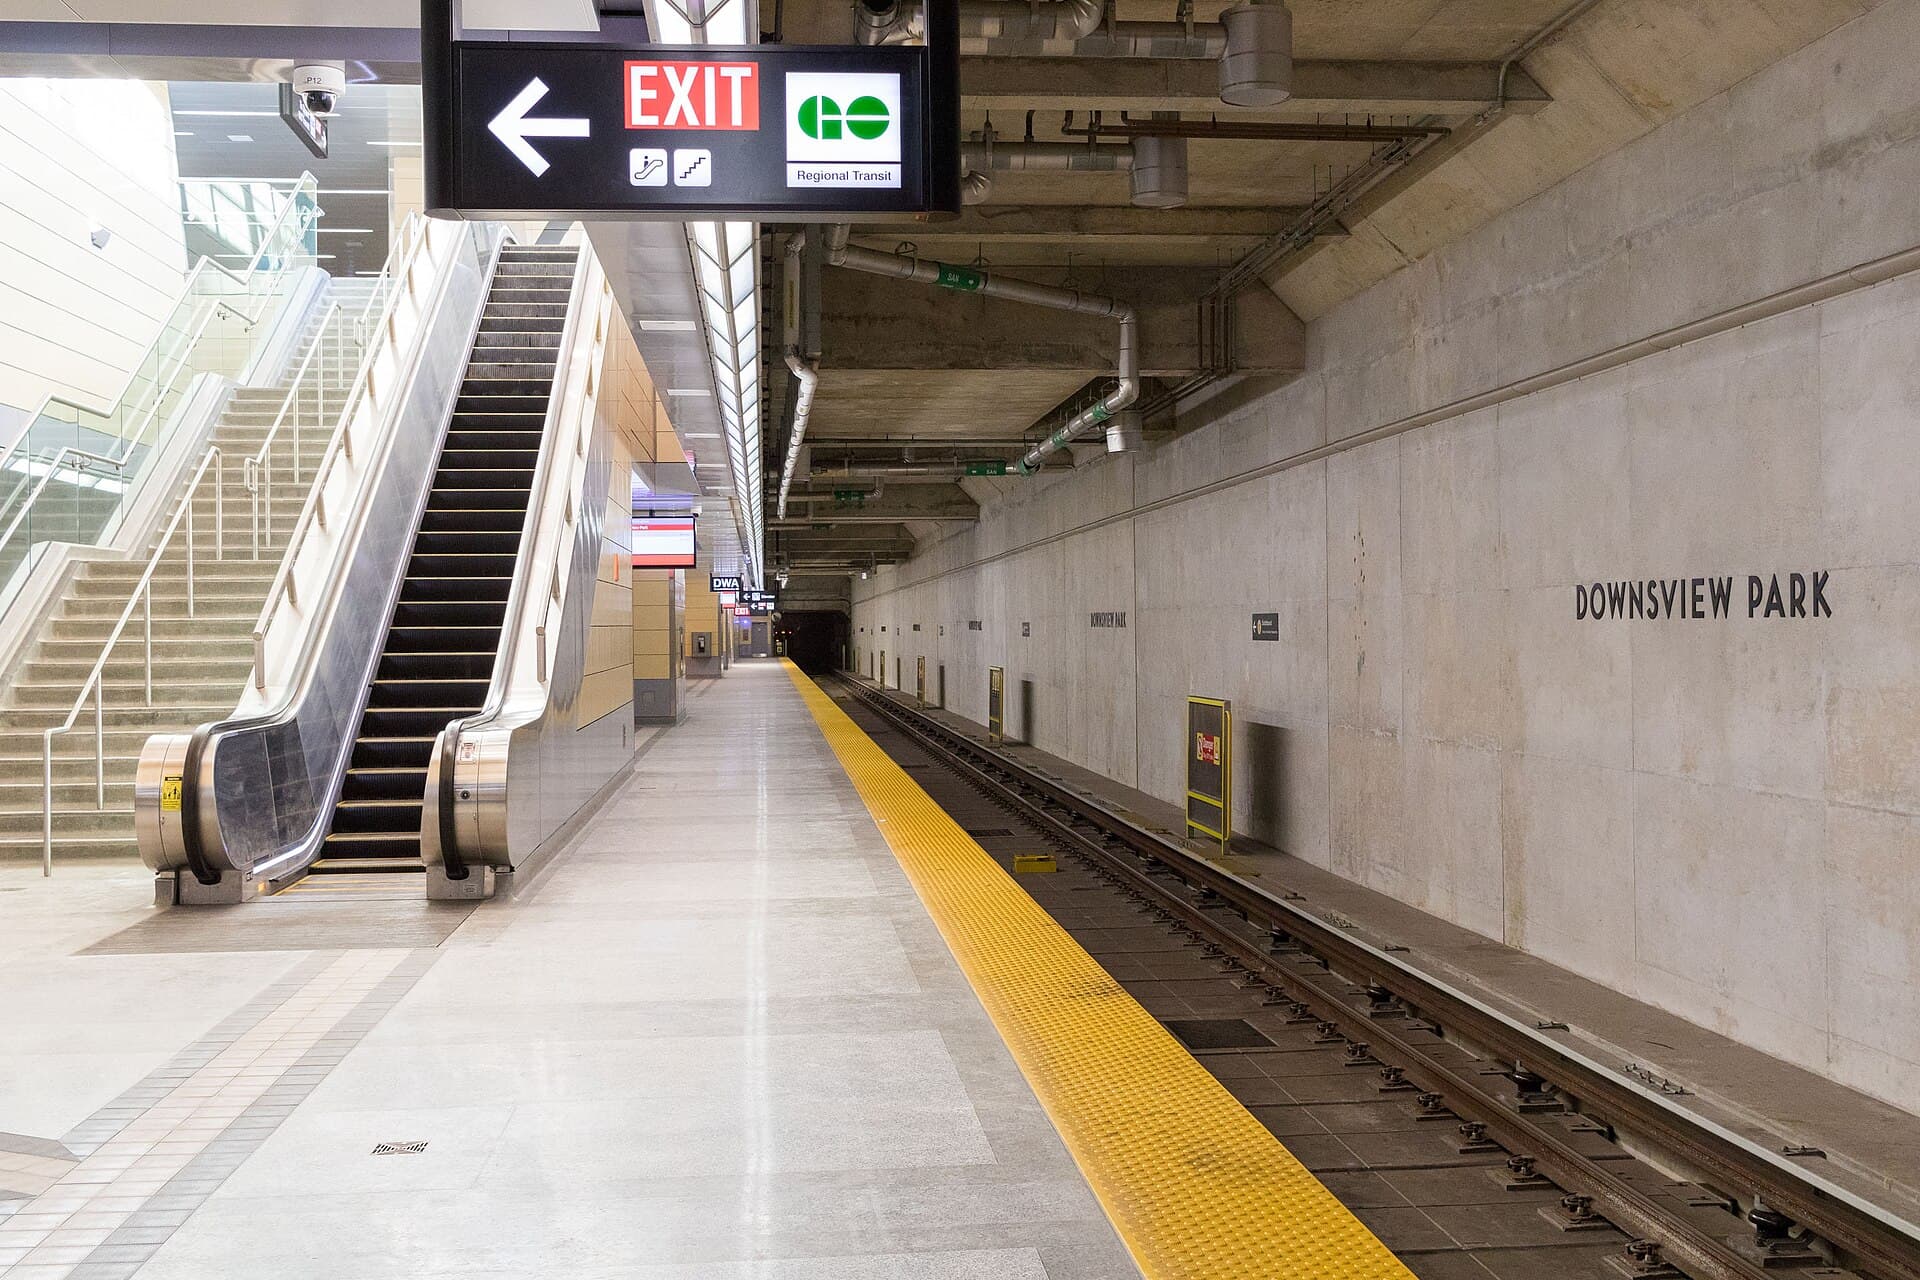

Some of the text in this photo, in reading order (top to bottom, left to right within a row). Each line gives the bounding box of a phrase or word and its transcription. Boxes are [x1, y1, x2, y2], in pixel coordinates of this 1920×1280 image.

[306, 76, 322, 85] P12
[630, 66, 752, 127] EXIT
[798, 95, 890, 140] GO
[797, 170, 892, 183] Regional Transit
[713, 578, 739, 588] DWA
[1576, 570, 1833, 620] DOWNSVIEW PARK
